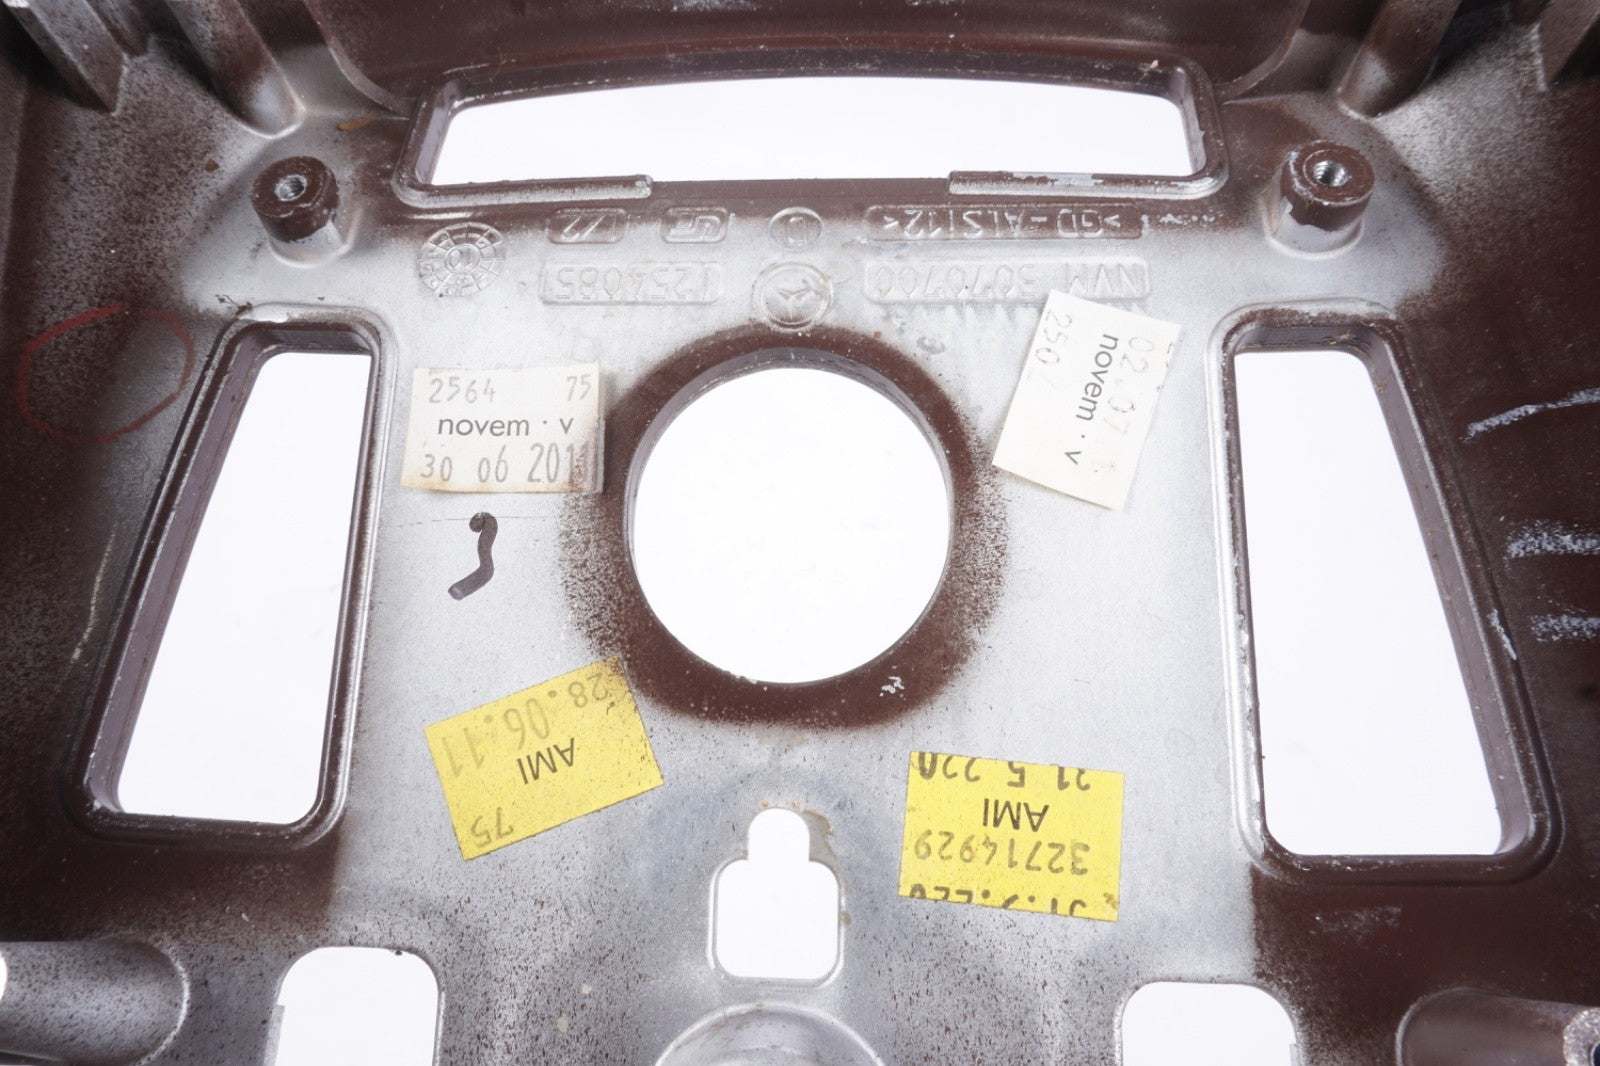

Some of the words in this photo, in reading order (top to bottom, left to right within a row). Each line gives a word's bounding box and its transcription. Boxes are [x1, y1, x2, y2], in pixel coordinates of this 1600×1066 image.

[428, 376, 496, 404] 2564
[566, 373, 592, 401] 75
[1075, 333, 1119, 421] novem
[437, 417, 530, 437] novem
[420, 453, 454, 482] 30
[477, 443, 509, 484] 06
[516, 737, 576, 785] AMI
[469, 806, 515, 849] 75
[982, 797, 1050, 833] AMI
[913, 828, 1091, 877] 32714929
